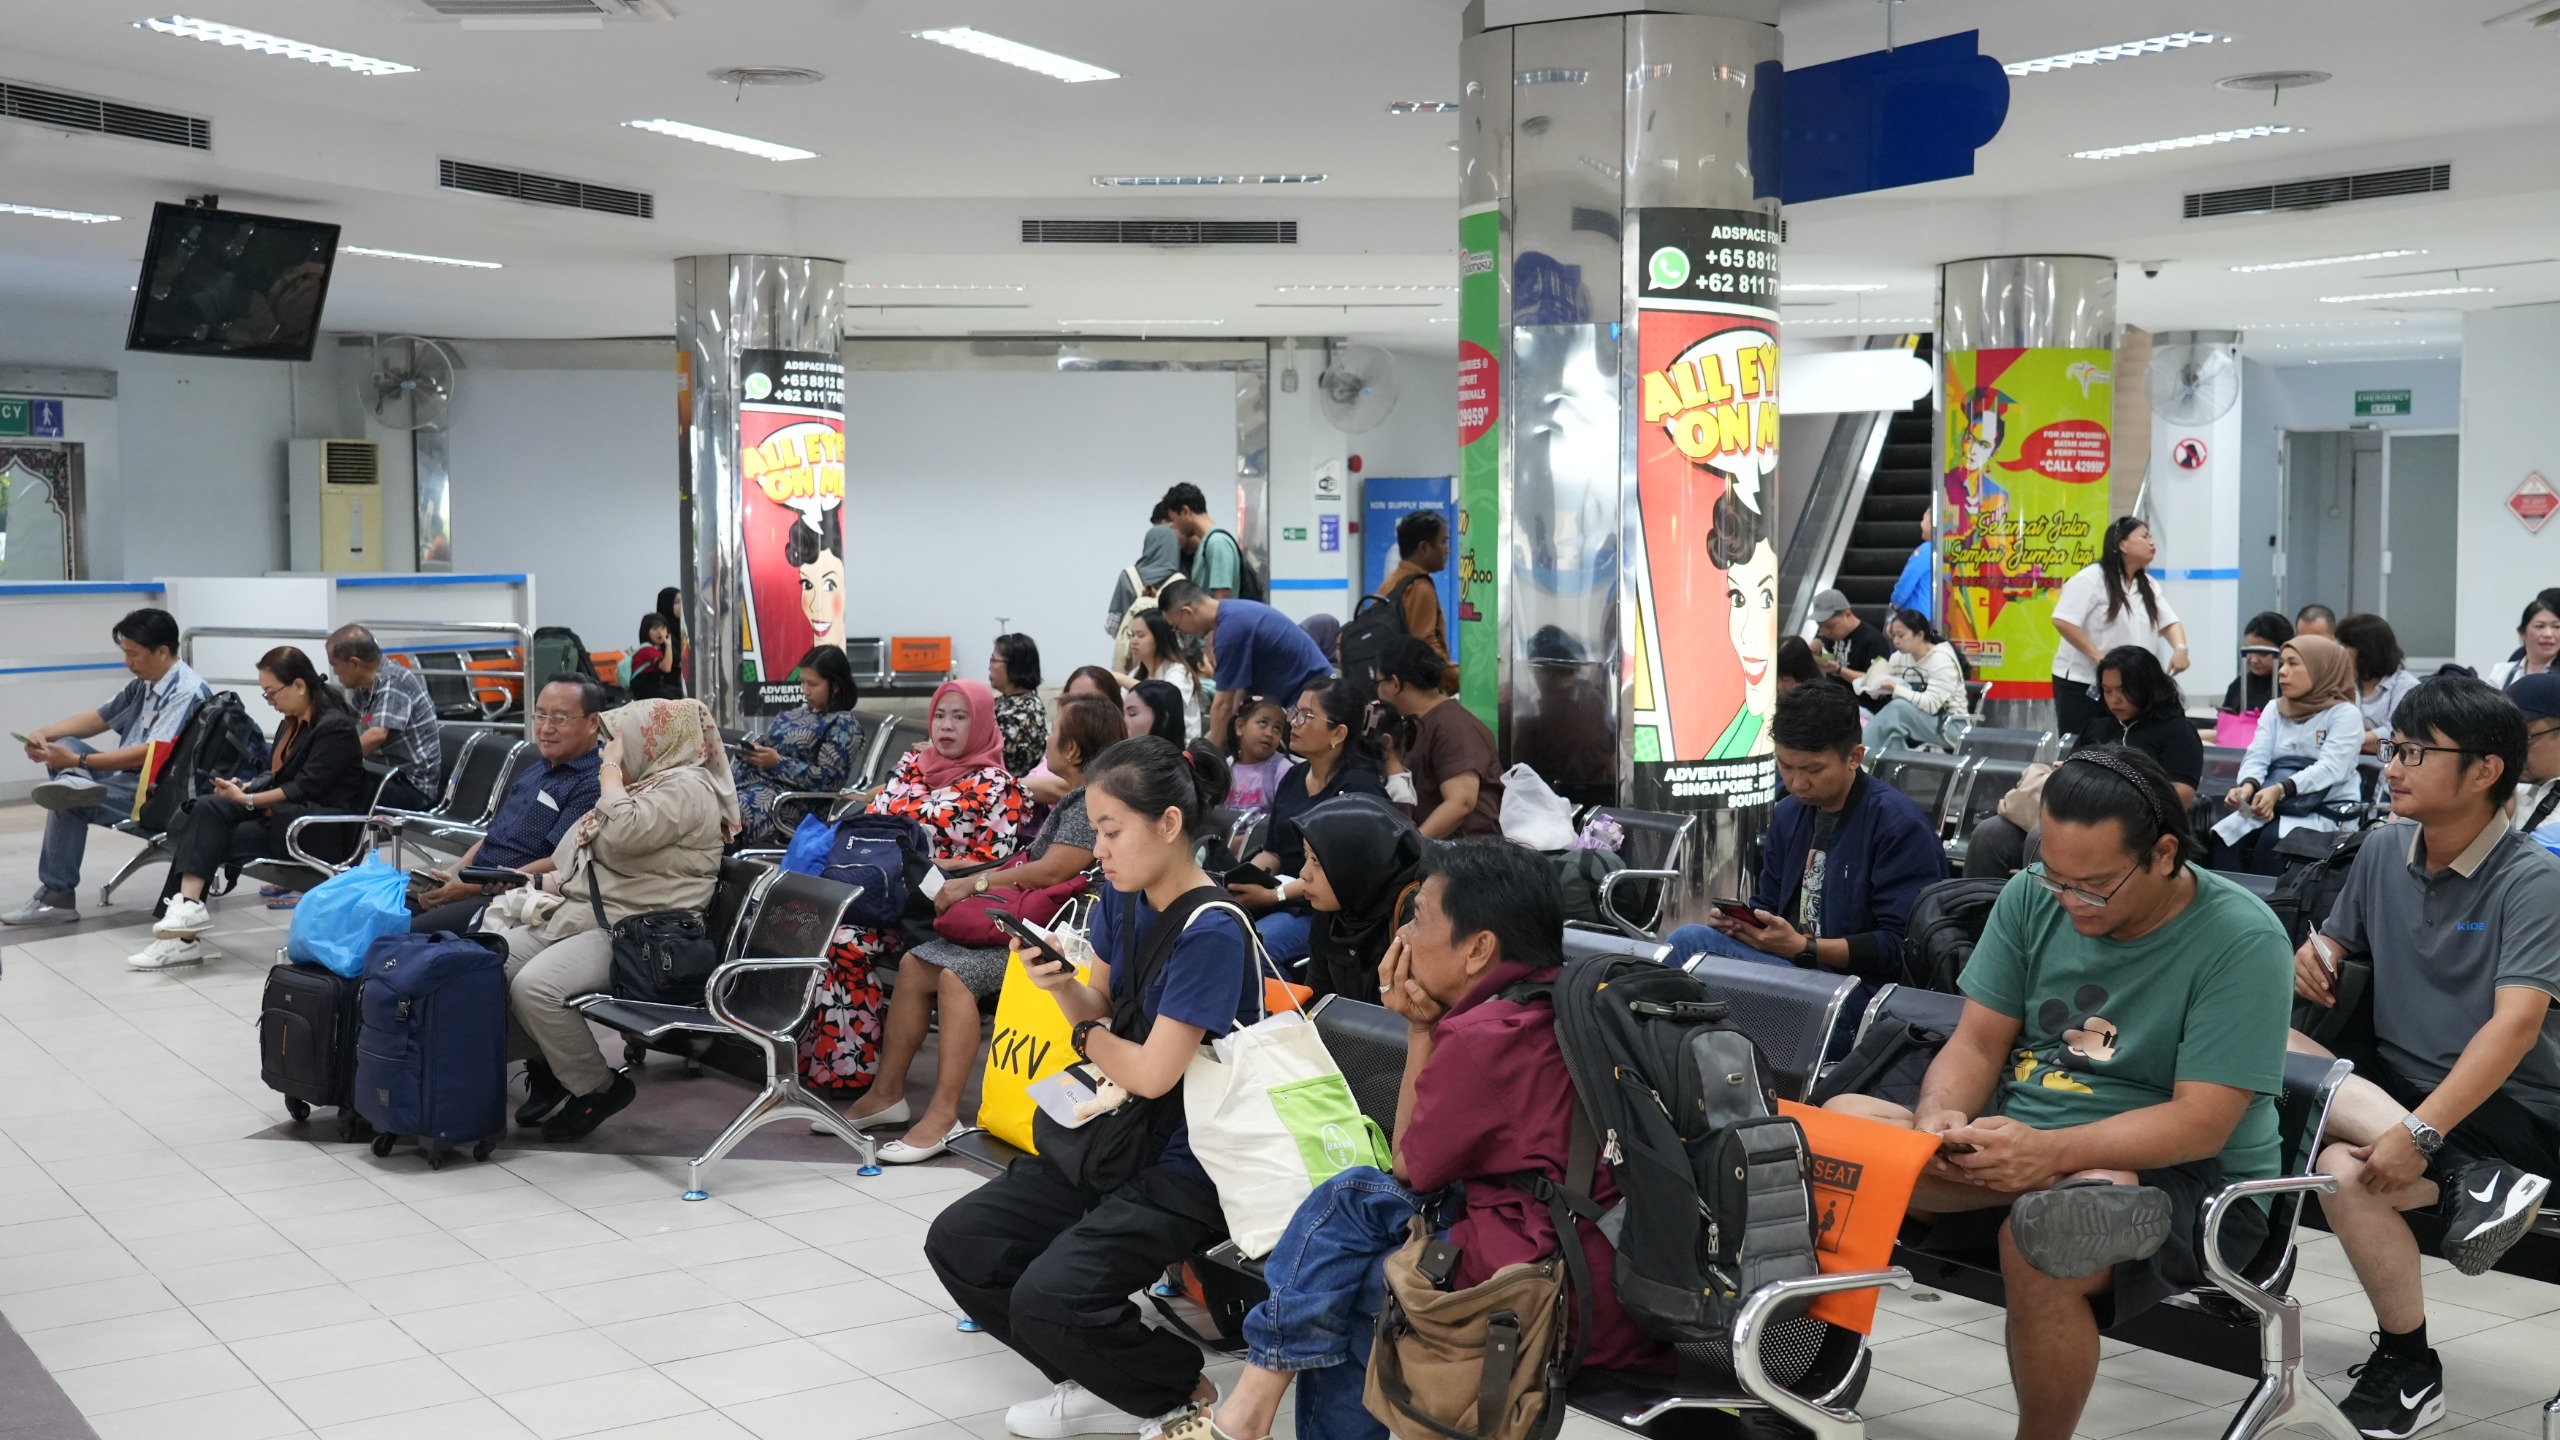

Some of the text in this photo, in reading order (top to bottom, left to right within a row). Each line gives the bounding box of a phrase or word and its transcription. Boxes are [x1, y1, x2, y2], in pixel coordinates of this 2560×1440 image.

[1711, 225, 1766, 243] ADSPACE
[1705, 248, 1777, 273] +65 8812
[1695, 273, 1734, 293] +62
[1738, 274, 1765, 295] 811
[785, 361, 825, 373] ADSPACE
[781, 375, 808, 388] +65
[809, 375, 836, 389] 8812
[1642, 342, 1779, 423] ALL EY
[775, 389, 802, 402] +62
[803, 390, 824, 403] 811
[1673, 402, 1751, 459] ON
[743, 438, 802, 479] ALL
[761, 466, 815, 502] ON
[1387, 501, 1417, 510] SUPPLY
[1418, 501, 1444, 510] DRINK
[1978, 510, 2091, 543] Selamat Jalan
[1951, 538, 2007, 572] Sampai
[2007, 537, 2068, 572] Jumpa
[1663, 763, 1757, 782] ADVERTISING
[1671, 778, 1753, 797] SINGAPORE
[1727, 792, 1763, 809] SOUTH
[1812, 1159, 1858, 1185] SEAT
